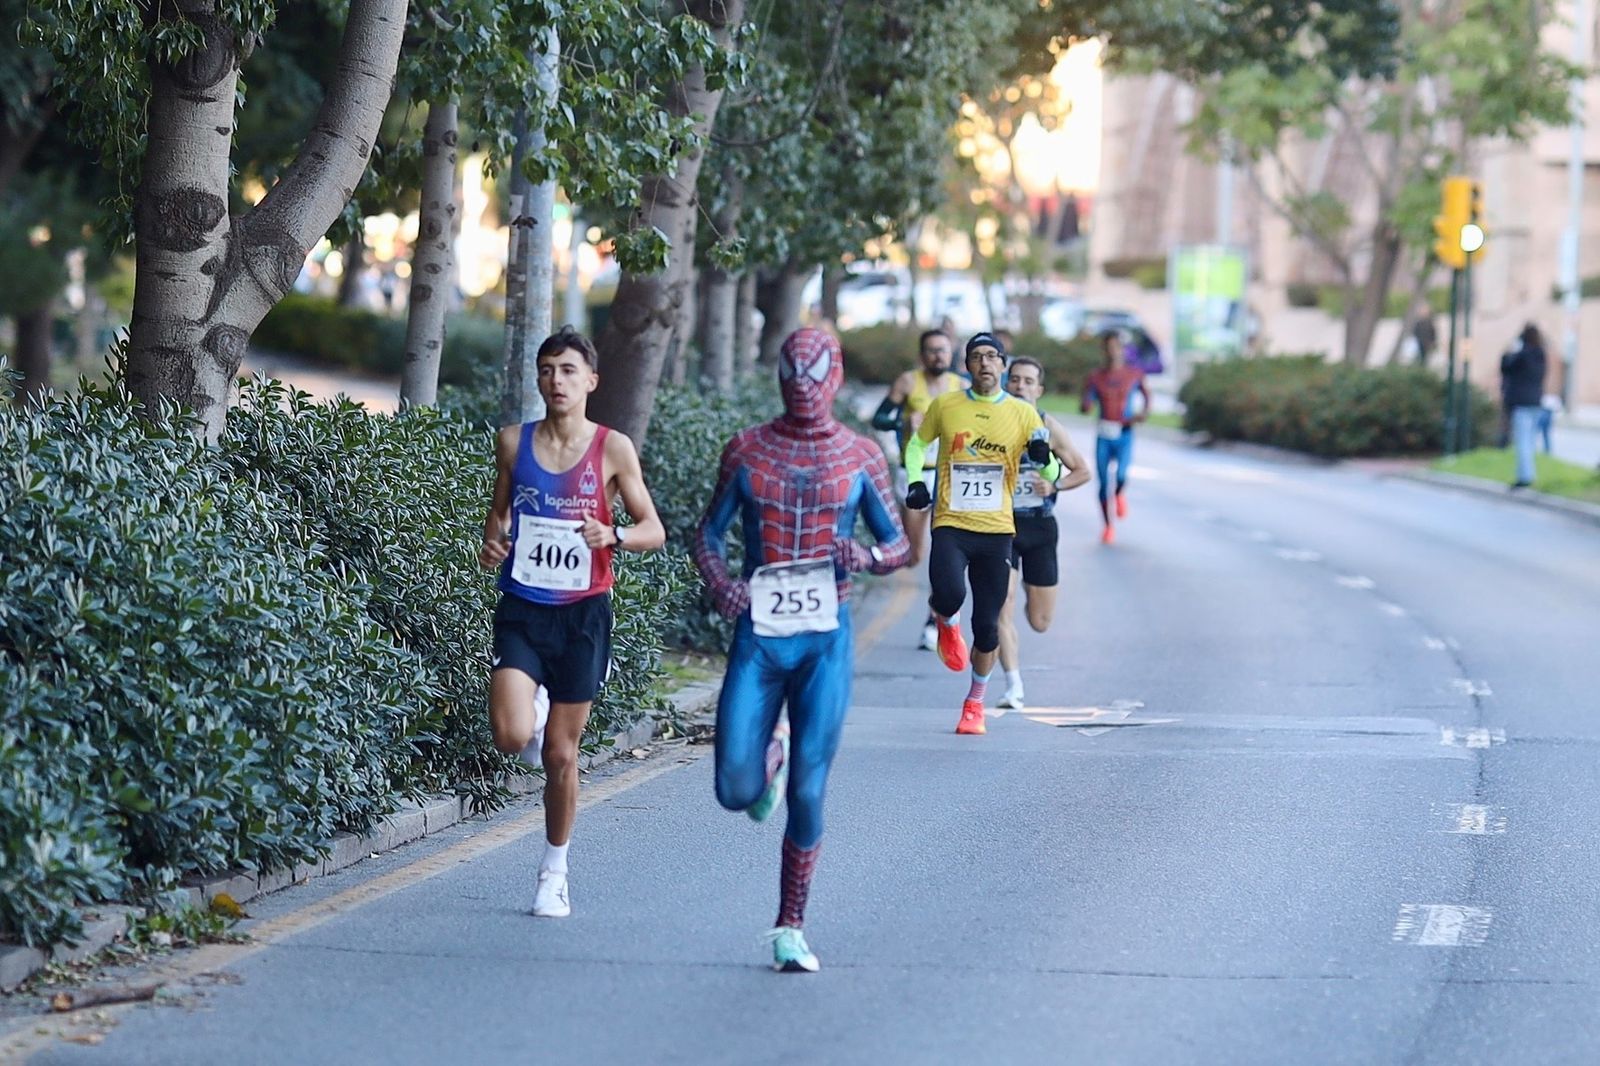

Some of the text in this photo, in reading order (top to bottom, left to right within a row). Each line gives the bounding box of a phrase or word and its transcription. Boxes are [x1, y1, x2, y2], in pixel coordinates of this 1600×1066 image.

[971, 435, 1006, 453] Álora
[961, 481, 992, 497] 715
[545, 493, 598, 510] lapalma
[528, 542, 580, 571] 406
[770, 588, 821, 614] 255
